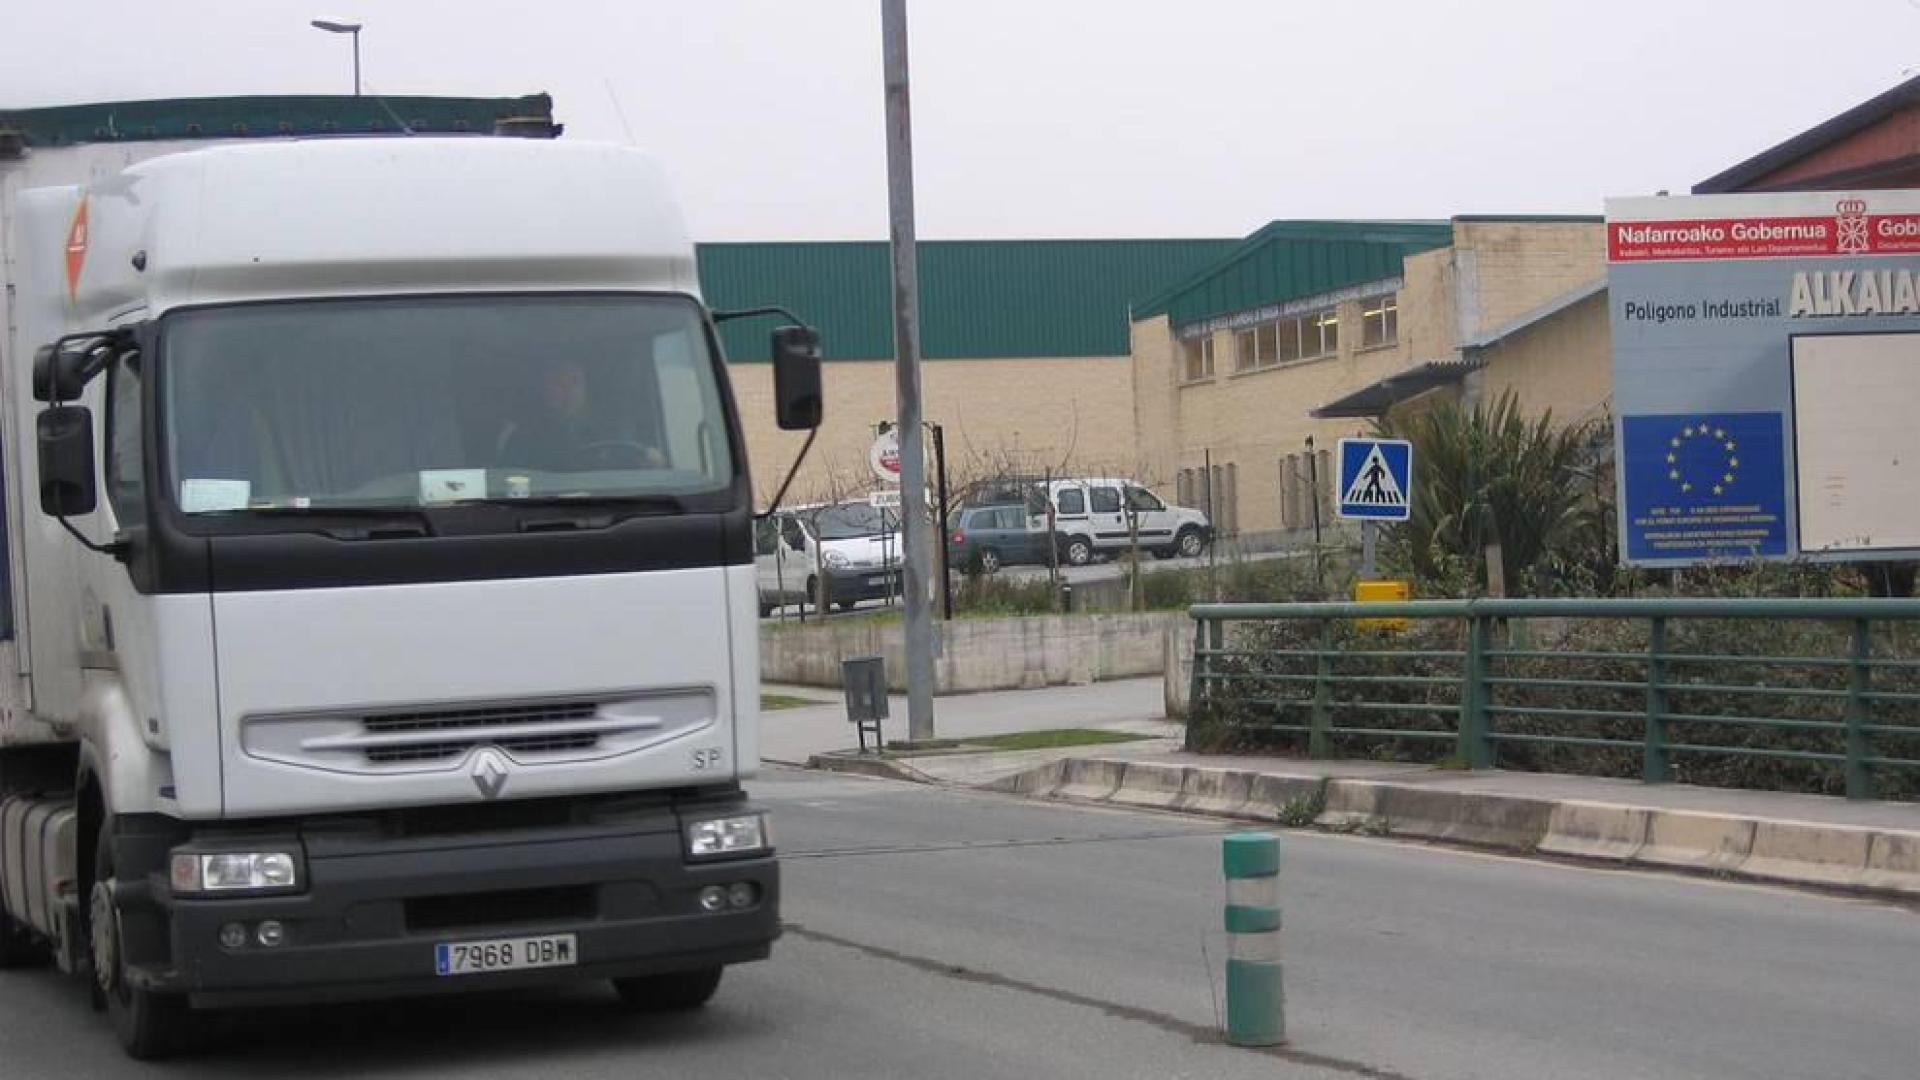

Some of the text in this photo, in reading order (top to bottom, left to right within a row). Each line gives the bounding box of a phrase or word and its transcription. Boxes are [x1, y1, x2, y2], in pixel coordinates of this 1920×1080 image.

[1618, 222, 1827, 244] Nafarroako Gobernua
[1703, 298, 1781, 318] Industrial
[1790, 270, 1920, 317] ALKAIA
[454, 944, 513, 969] 7968
